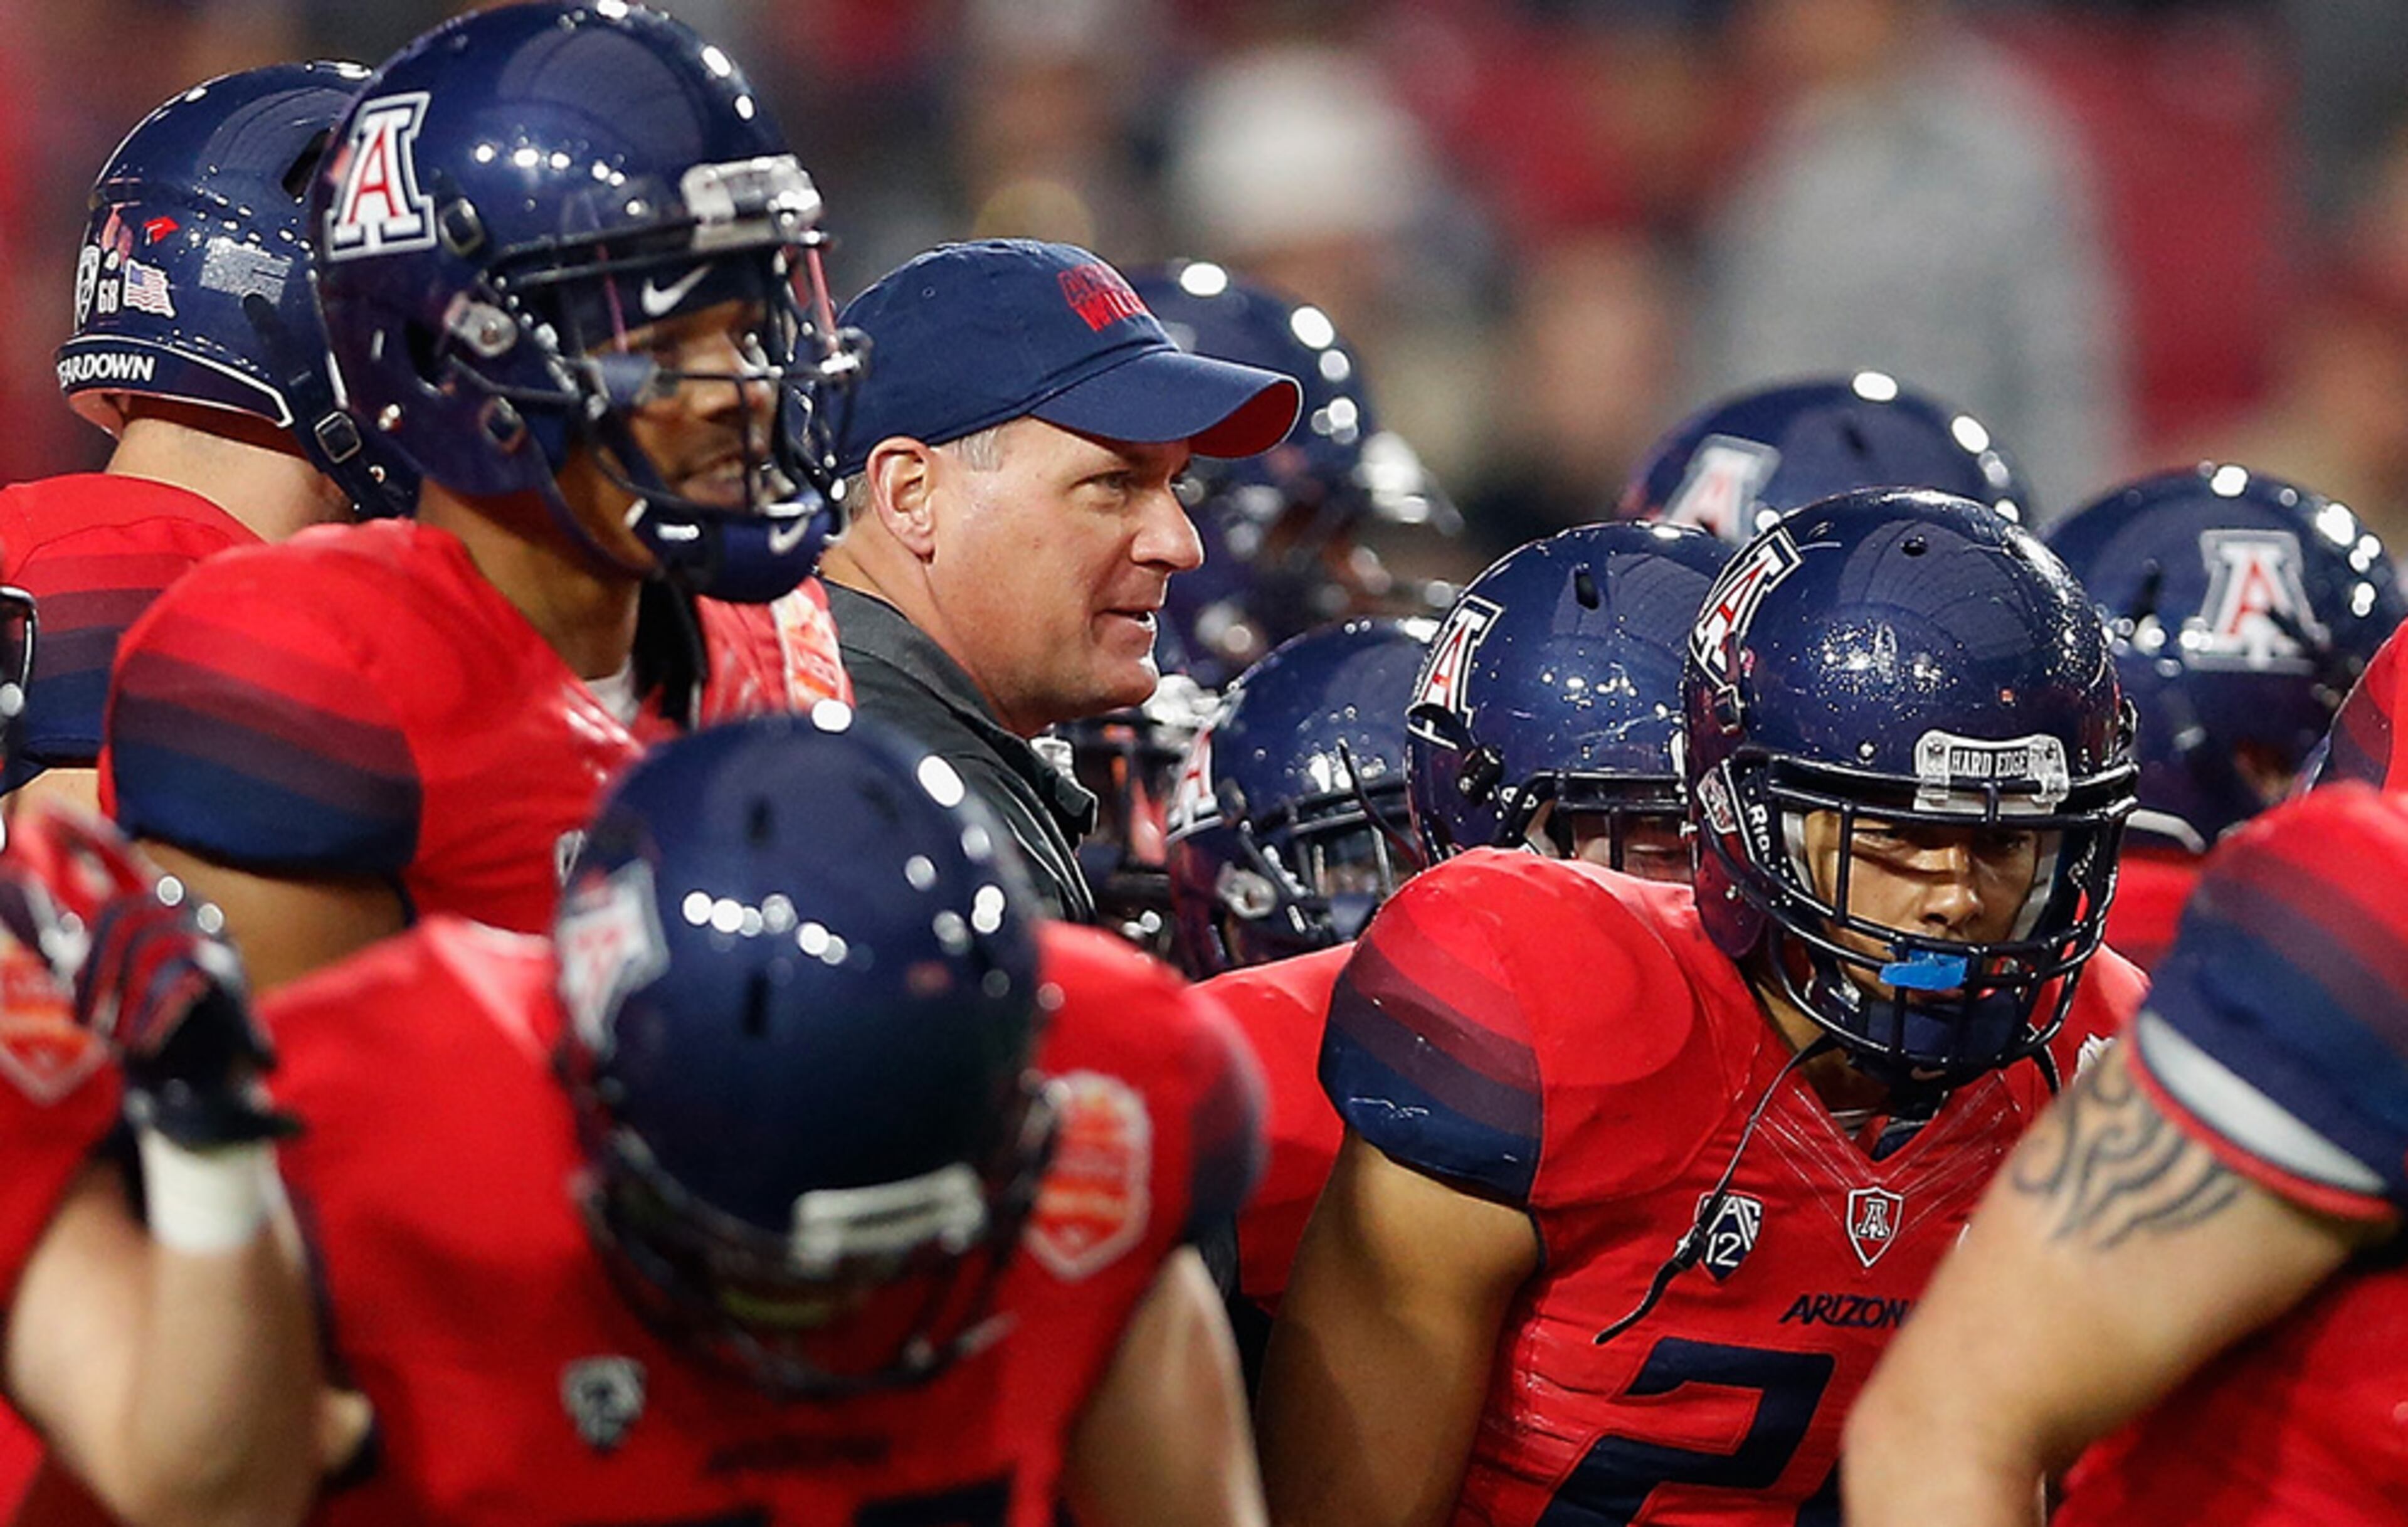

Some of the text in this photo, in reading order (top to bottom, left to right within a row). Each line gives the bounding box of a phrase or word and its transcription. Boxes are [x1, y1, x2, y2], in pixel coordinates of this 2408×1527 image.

[324, 92, 437, 262] A
[98, 280, 119, 313] 68
[56, 353, 155, 389] EARDOWN
[1689, 526, 1804, 691] A
[2184, 529, 2331, 675] A
[1405, 593, 1504, 750] A
[1951, 750, 2028, 777] HARD EDGE
[1706, 1232, 1741, 1267] 12
[1777, 1292, 1909, 1328] ARIZON
[1535, 1337, 1841, 1527] 2
